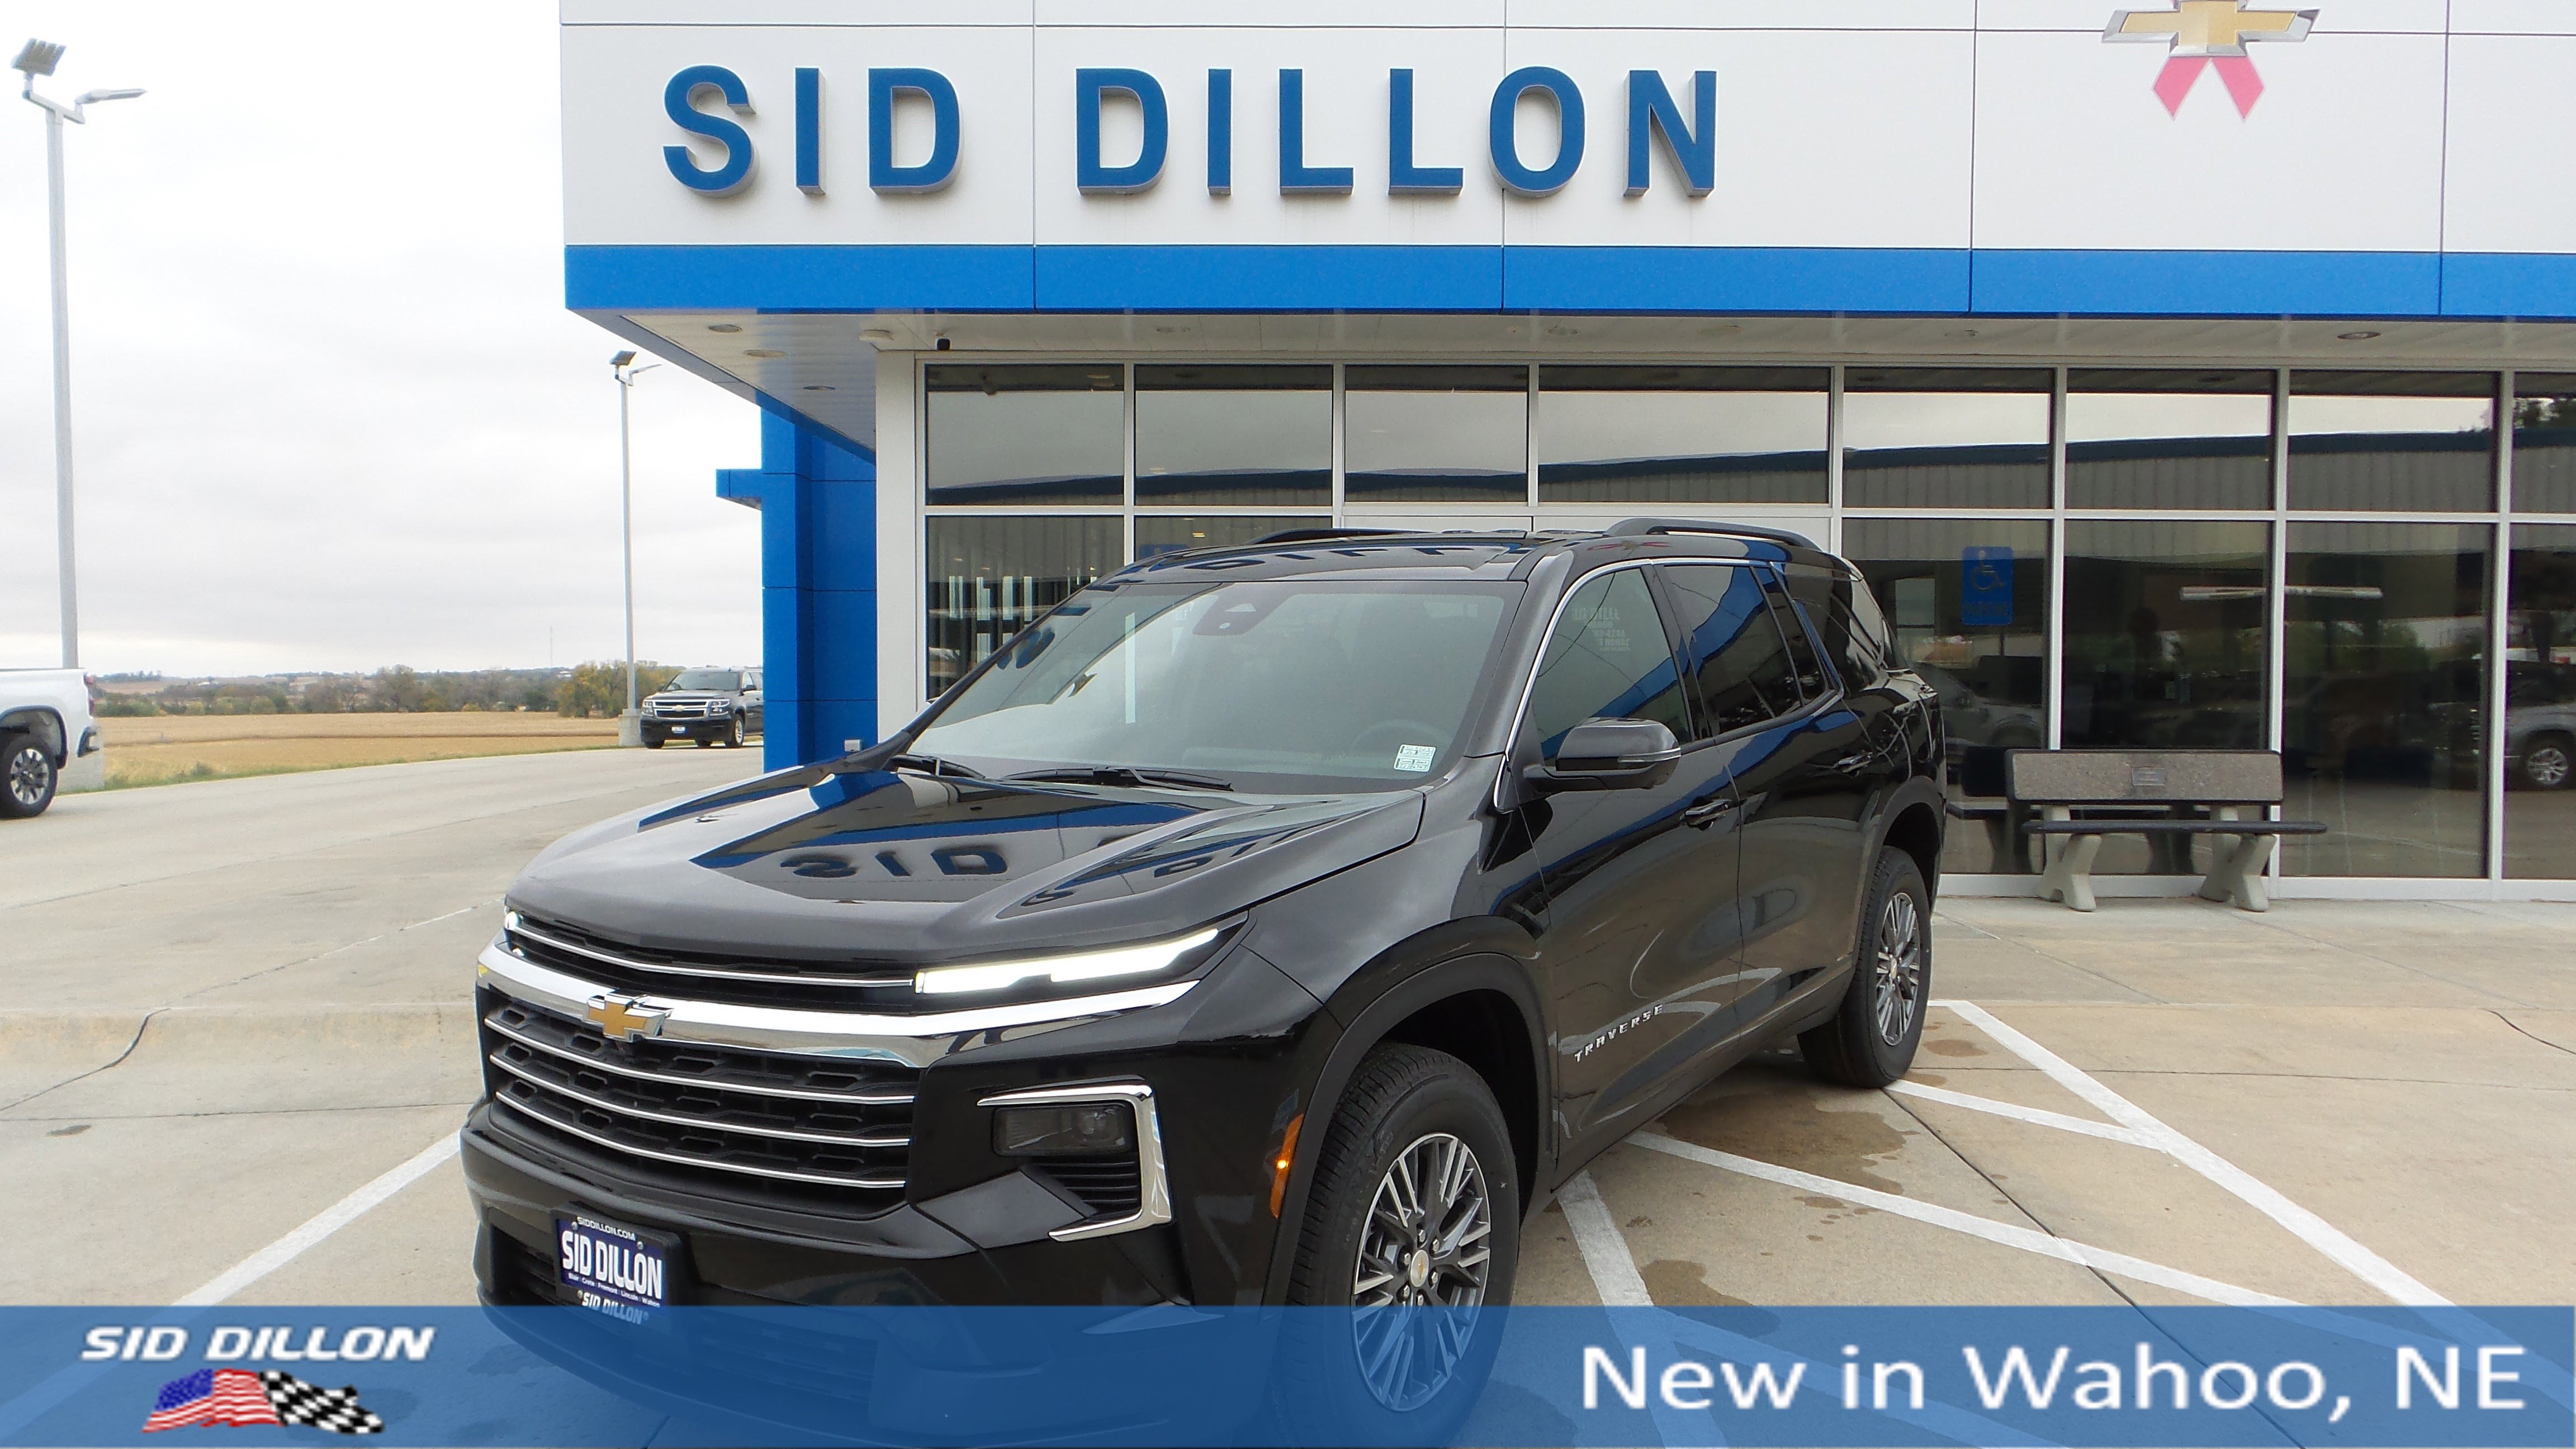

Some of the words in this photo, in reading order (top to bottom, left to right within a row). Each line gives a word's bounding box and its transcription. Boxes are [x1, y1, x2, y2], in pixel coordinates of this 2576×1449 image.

[663, 65, 960, 197] SID
[1076, 67, 1717, 198] DILLON
[1574, 1005, 1663, 1062] TRAVERSE
[576, 1216, 636, 1241] SIDDILLON.COM
[561, 1230, 591, 1276] SID
[595, 1240, 662, 1300] DILLON
[581, 1292, 600, 1310] SID
[602, 1298, 643, 1325] DILLON
